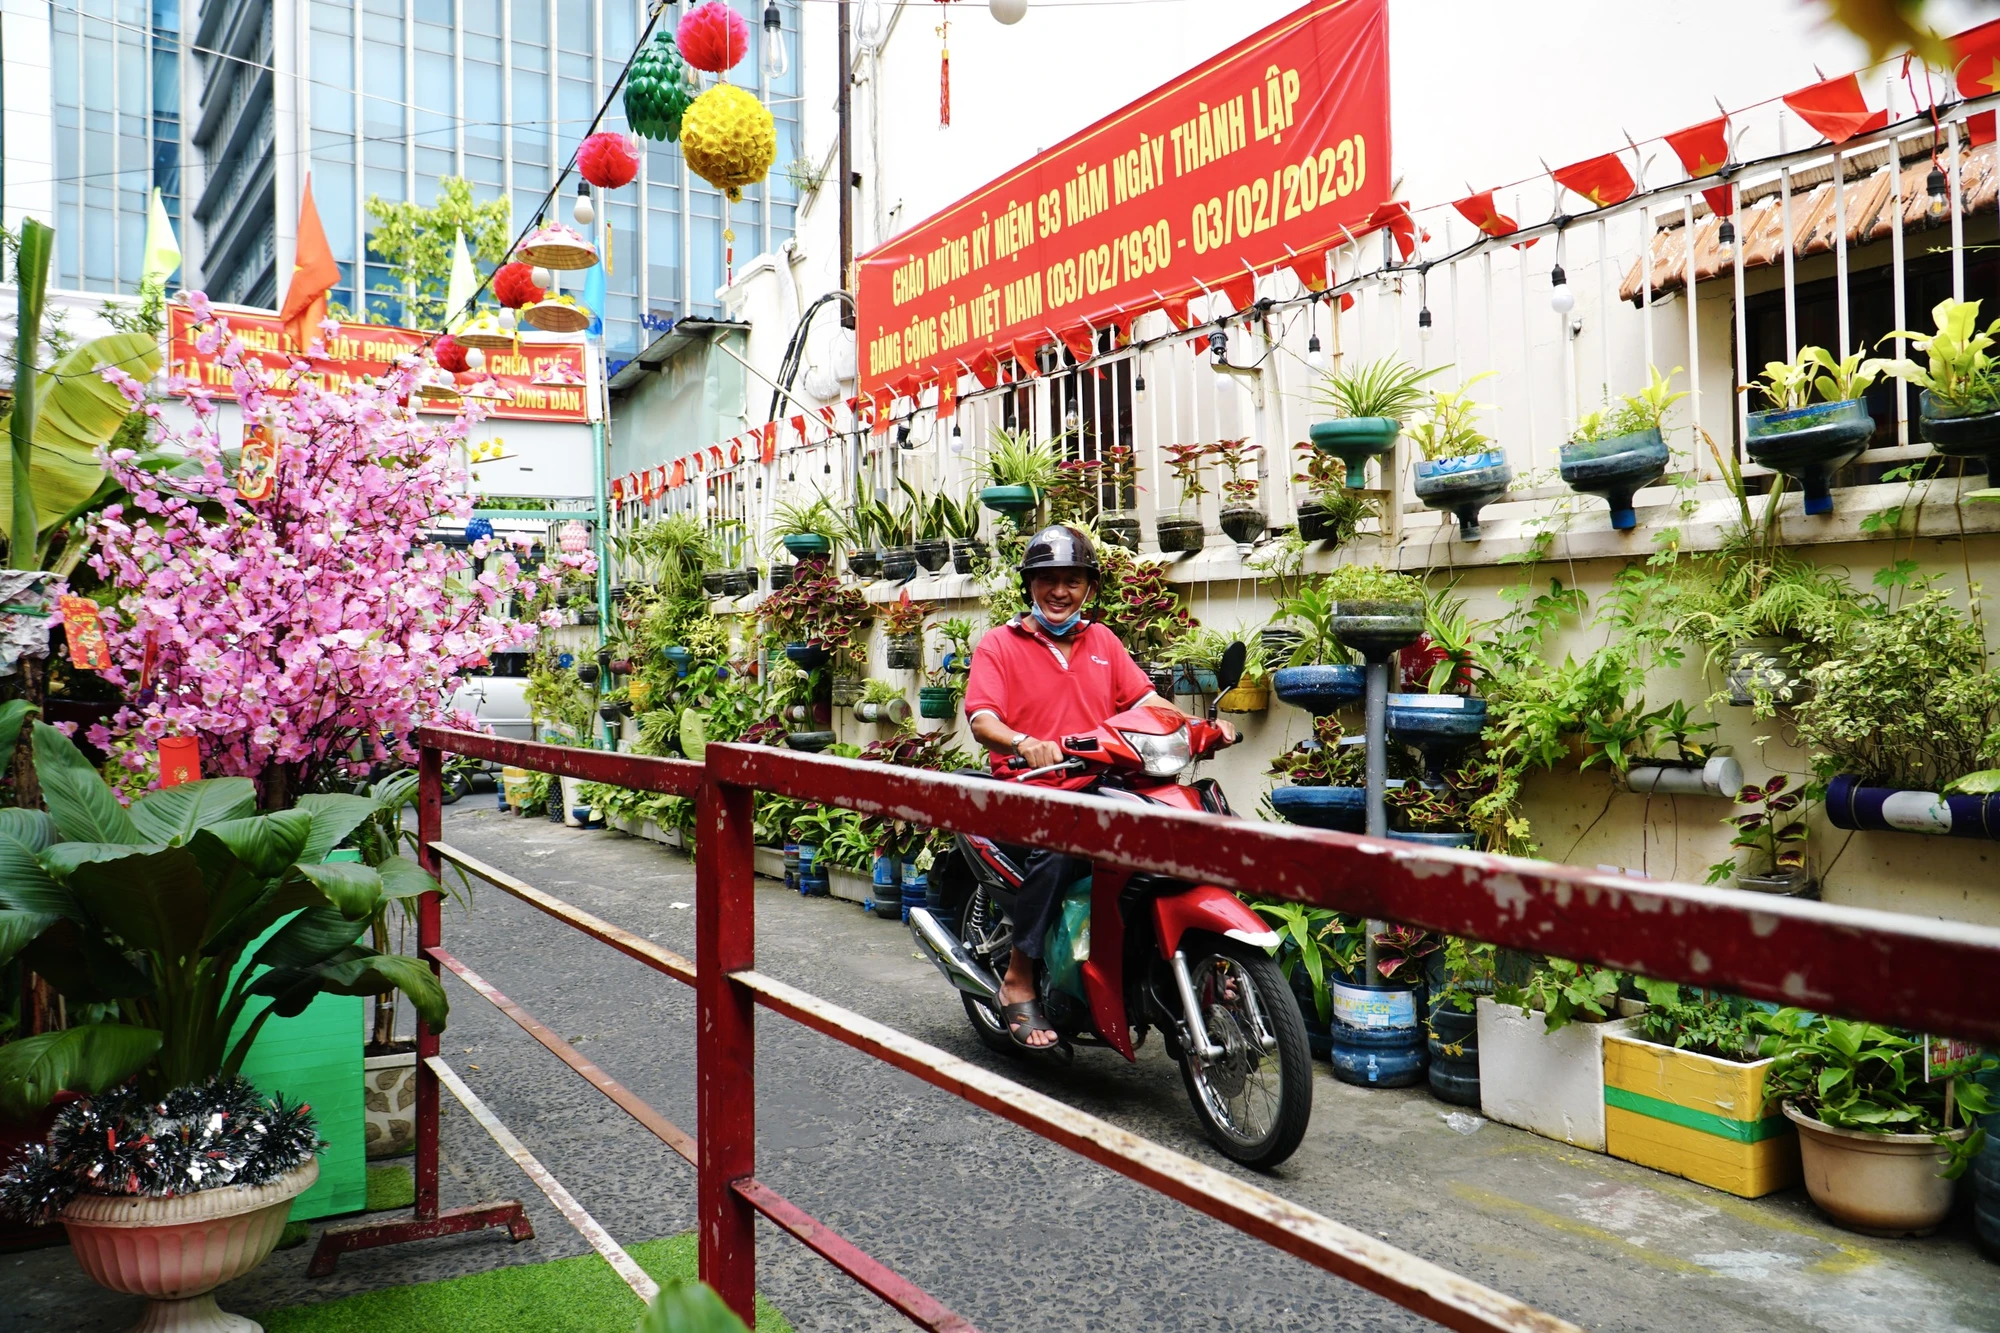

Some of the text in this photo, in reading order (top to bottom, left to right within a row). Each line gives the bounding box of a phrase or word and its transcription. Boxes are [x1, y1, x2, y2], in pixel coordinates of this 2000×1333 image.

[870, 134, 1366, 376] ĐẢNG CỘNG SẢN VIỆT NAM (03/02/1930 - 03/02/2023)
[893, 64, 1300, 307] CHÀO MỪNG KỶ NIỆM 93 NĂM NGÀY THÀNH LẬP
[549, 387, 580, 411] DÂN
